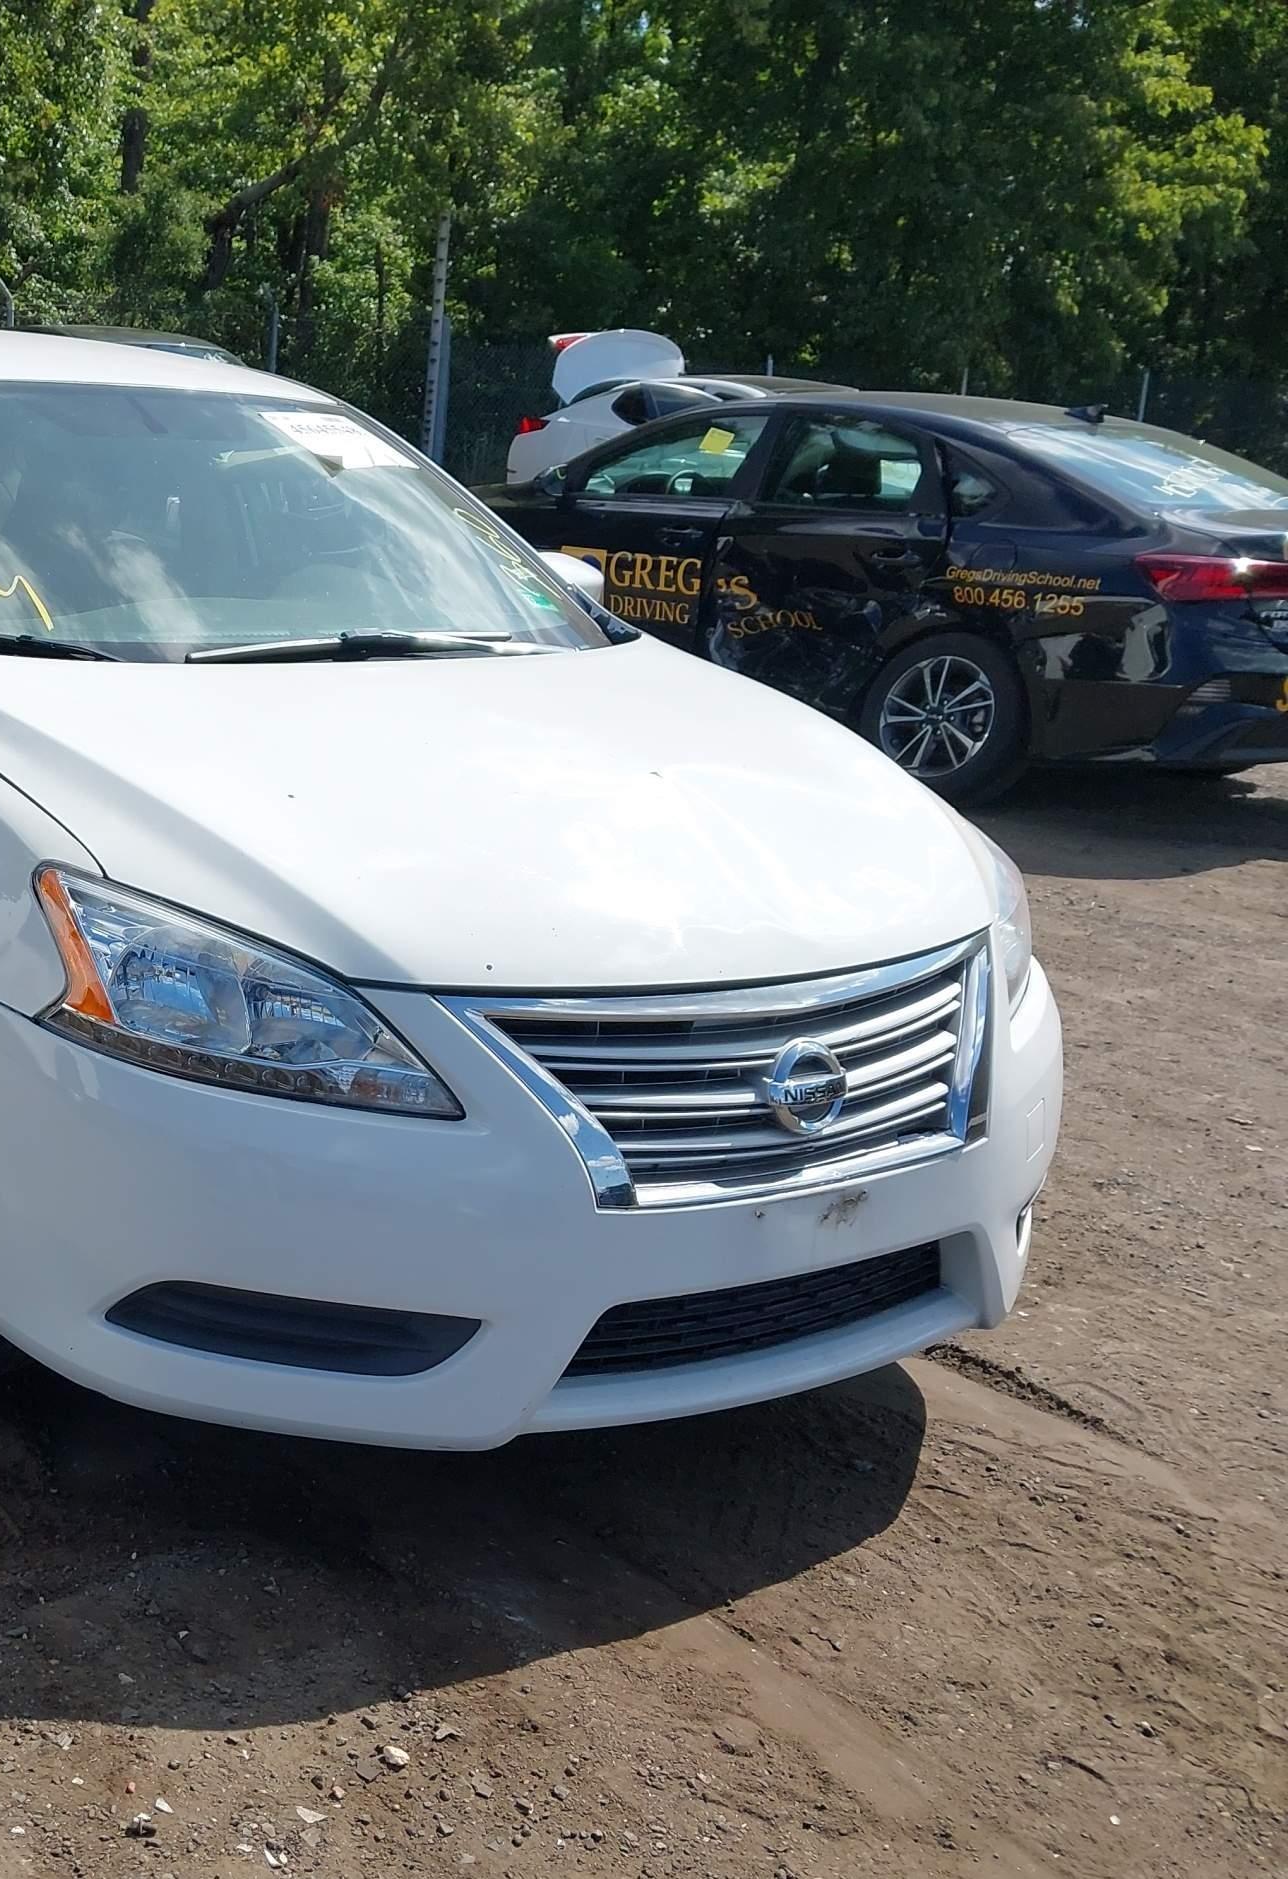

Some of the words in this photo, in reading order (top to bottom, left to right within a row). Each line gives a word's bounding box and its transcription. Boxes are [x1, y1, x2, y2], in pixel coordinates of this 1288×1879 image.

[945, 565, 1102, 591] GregsDrivingSchool.net
[952, 585, 1086, 616] 800.456.1255
[610, 594, 690, 625] DRIVING
[727, 609, 824, 639] SCHOOL
